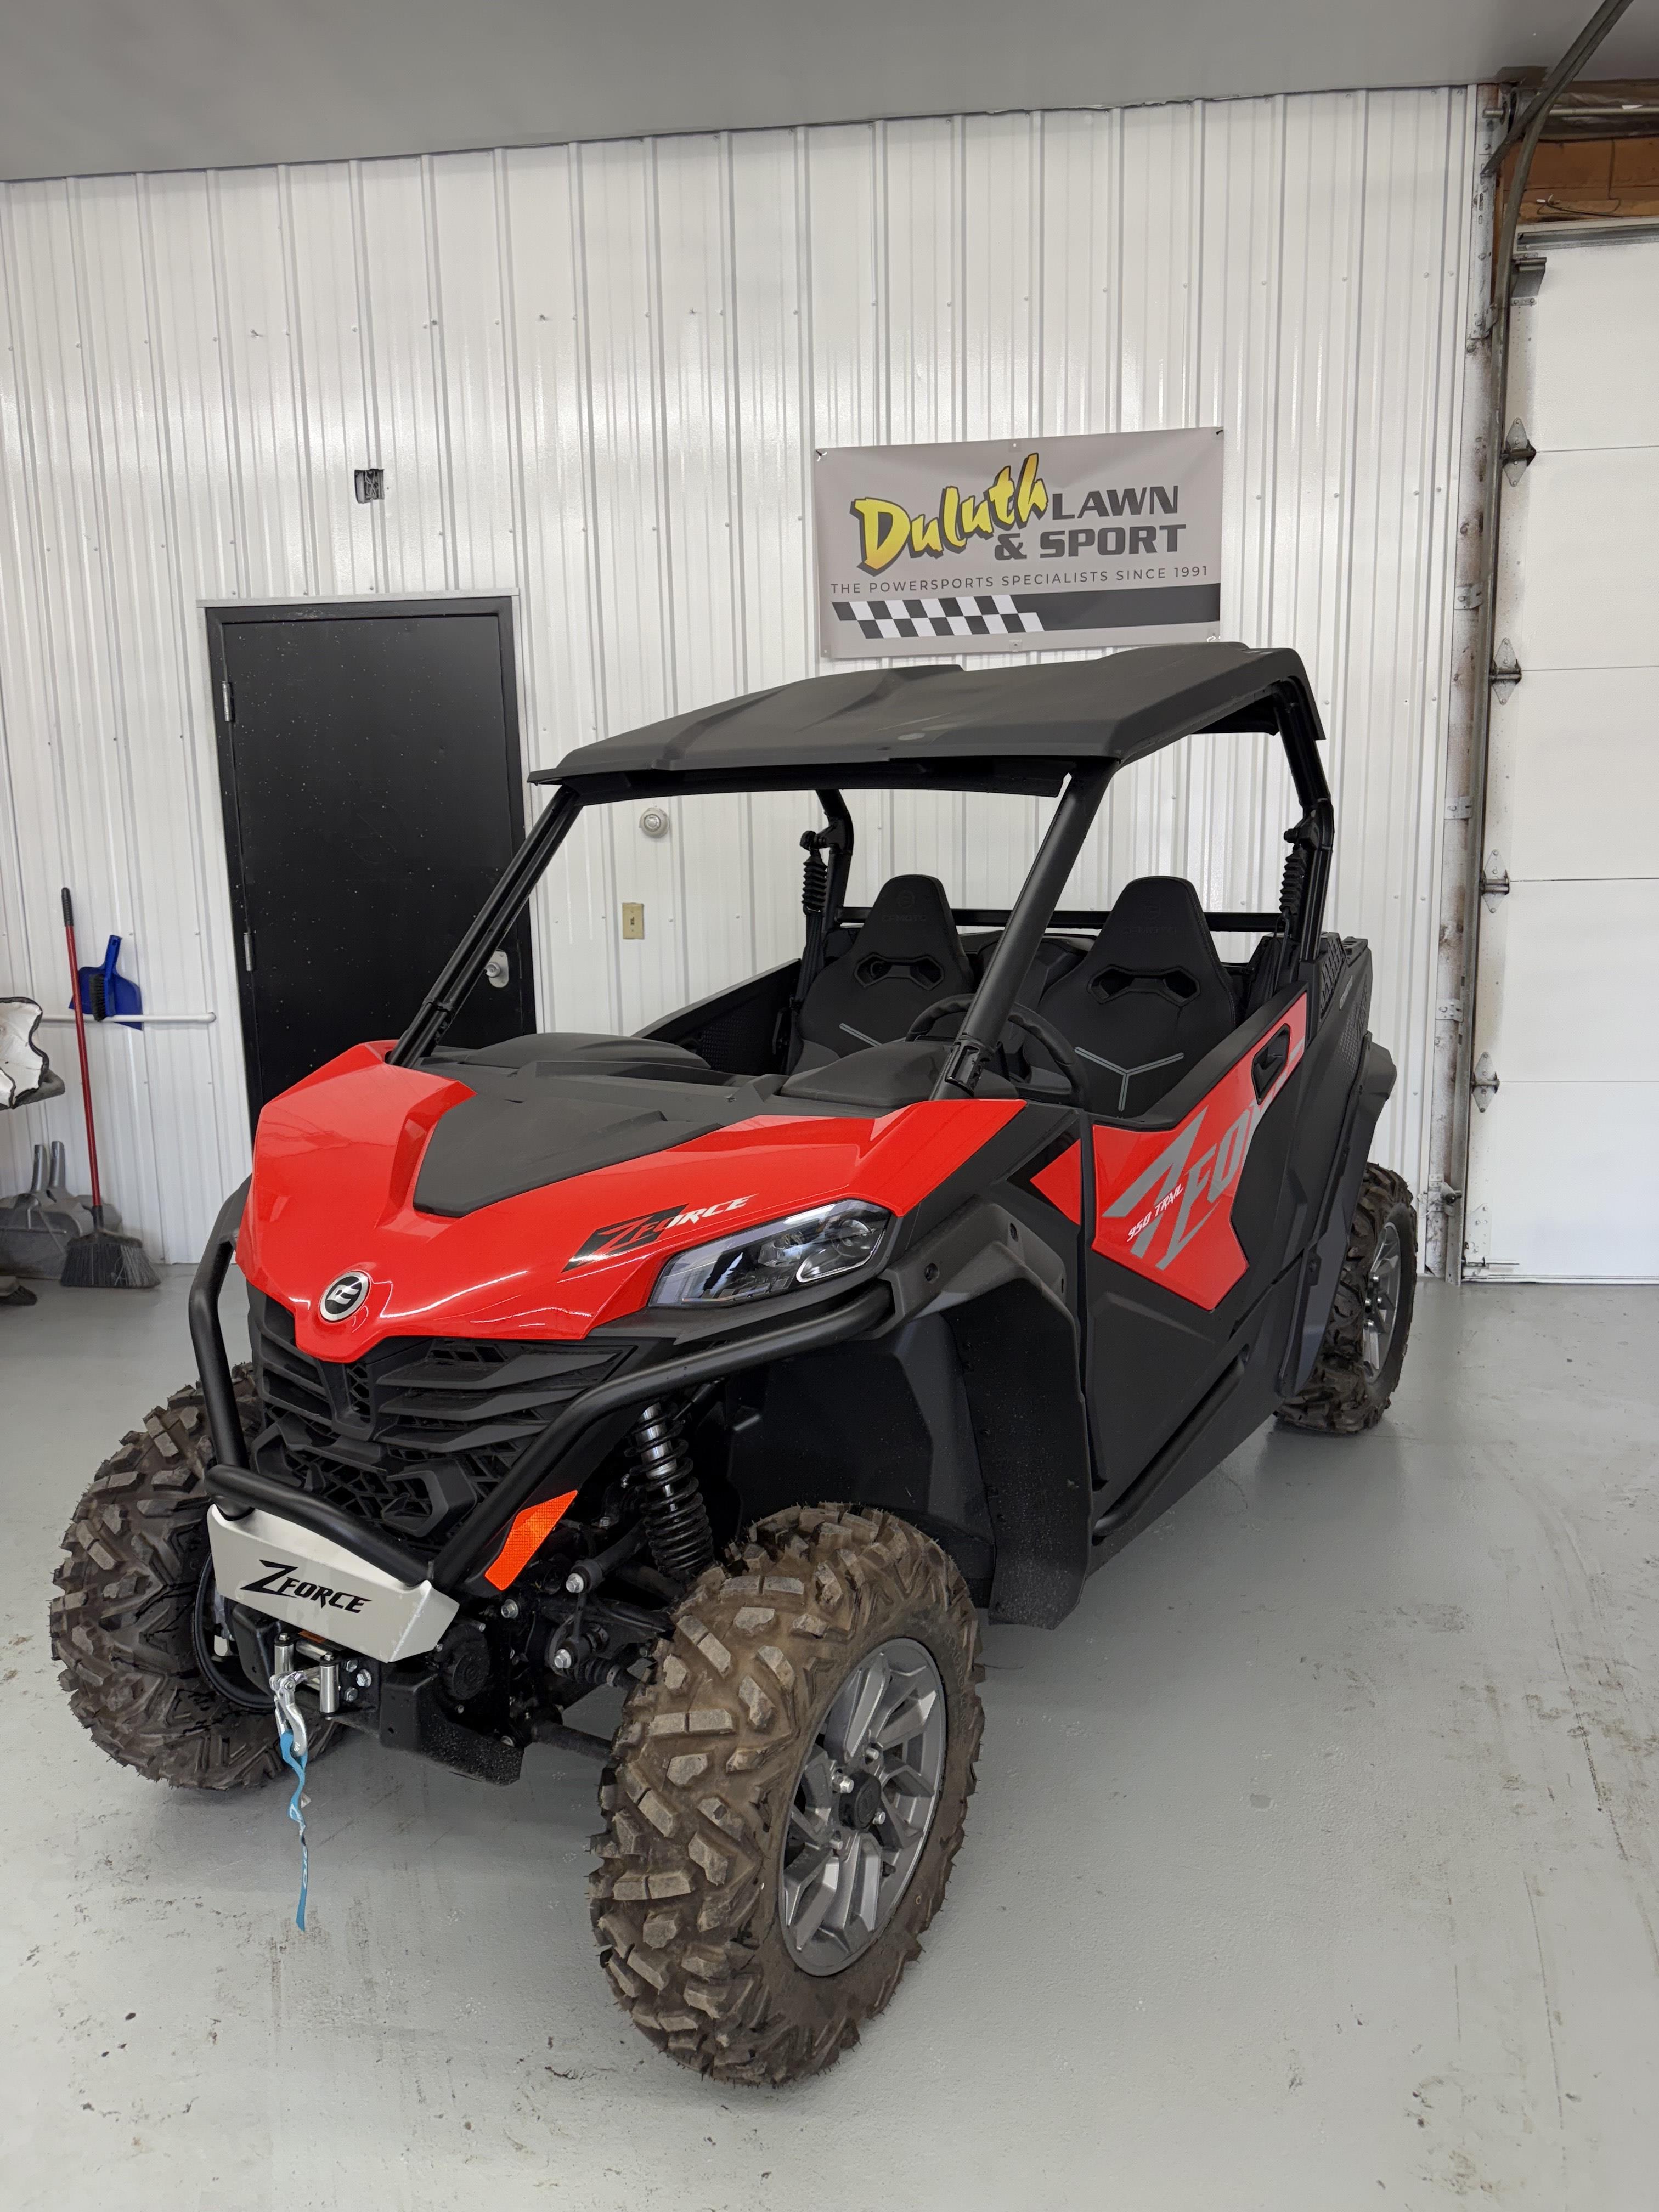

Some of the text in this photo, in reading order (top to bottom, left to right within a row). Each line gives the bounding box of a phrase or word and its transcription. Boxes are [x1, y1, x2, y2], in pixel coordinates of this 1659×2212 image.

[850, 452, 1178, 577] Duluth LAWN
[994, 524, 1186, 561] & SPORT
[831, 566, 1206, 594] THE POWERSPORTS SPECIALISTS SINCE 1991
[1127, 1183, 1184, 1242] 950 TRAIL
[240, 1559, 372, 1613] ZFORCE
